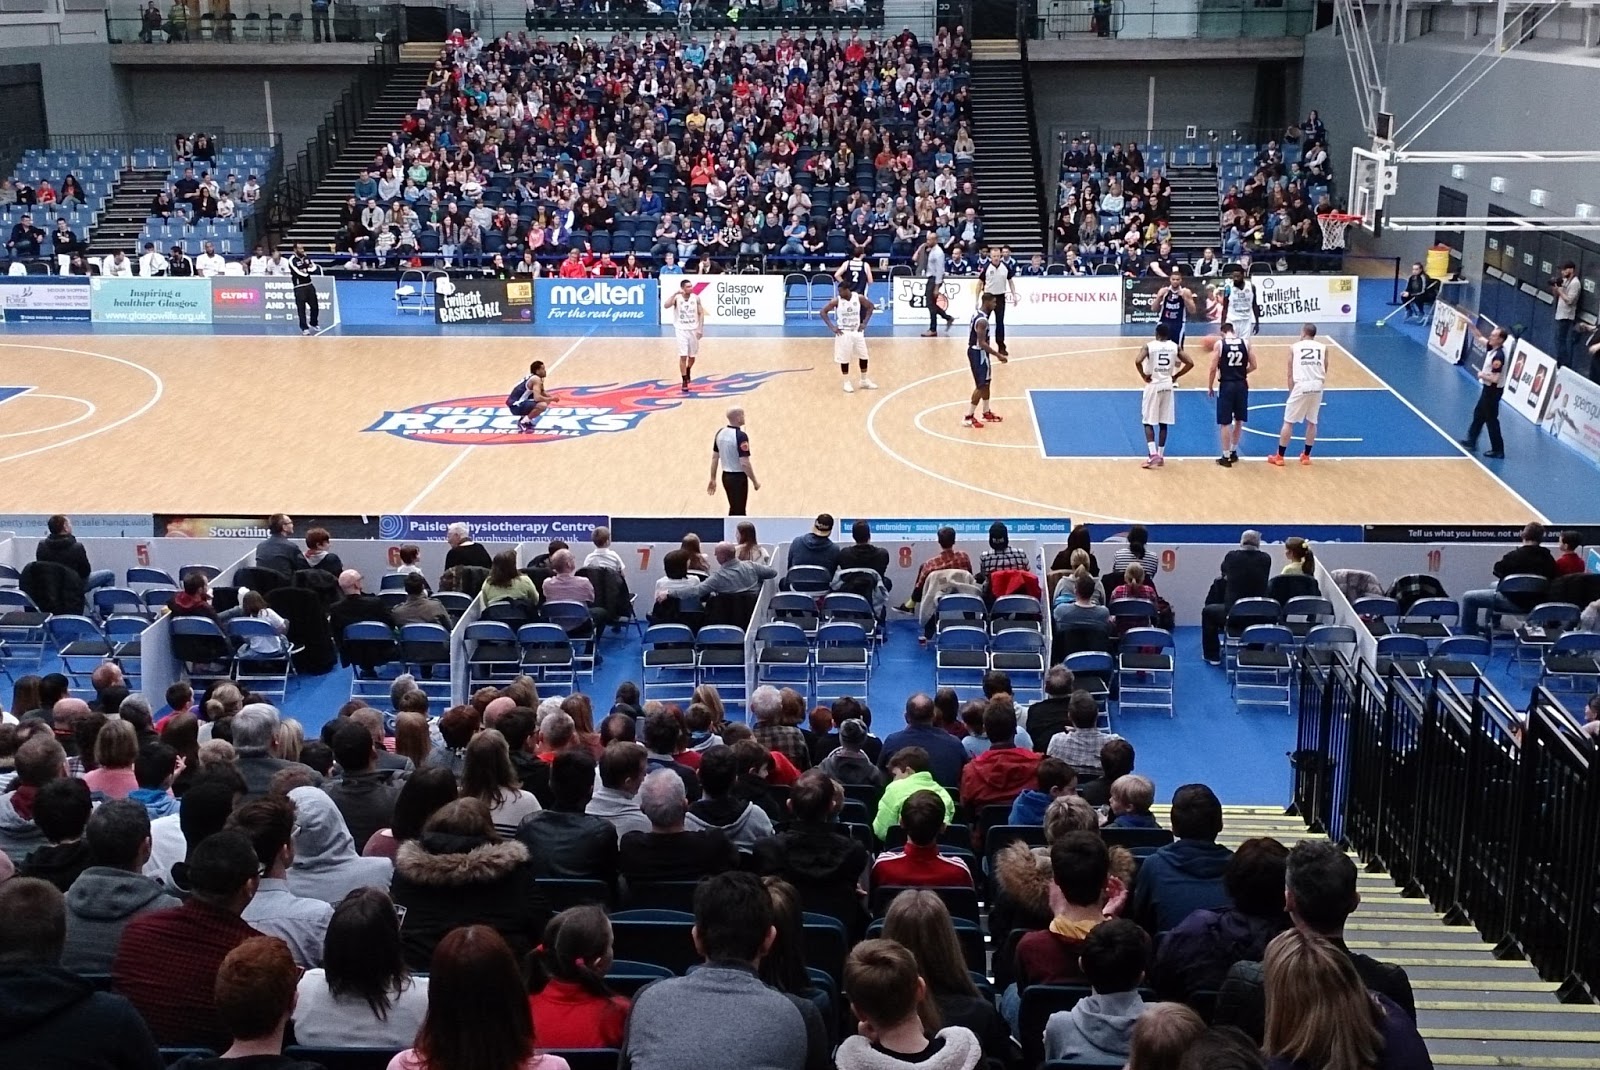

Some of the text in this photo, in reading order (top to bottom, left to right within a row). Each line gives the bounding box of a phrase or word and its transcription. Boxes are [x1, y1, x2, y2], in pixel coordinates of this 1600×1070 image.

[852, 271, 859, 282] 2
[130, 289, 173, 300] Inspiring
[221, 292, 254, 300] CLYDE 1
[265, 292, 284, 300] FOR
[550, 282, 645, 306] molten
[716, 282, 764, 296] Glasgow
[898, 280, 960, 302] jup
[1262, 286, 1301, 304] twilight
[113, 298, 198, 309] healthier Glasgow
[443, 290, 482, 308] twilight
[717, 294, 751, 305] Kelvin
[1041, 292, 1118, 303] PHOENIX KIA
[1132, 298, 1147, 306] One
[265, 302, 285, 310] AND
[439, 301, 502, 323] BASKETBALL
[716, 305, 756, 319] College
[1257, 297, 1321, 318] BASKETBALL
[105, 311, 207, 322] www.glasgowlife.org.uk
[547, 307, 645, 322] For the real game
[1158, 353, 1171, 366] 5
[1227, 351, 1243, 367] 22
[1300, 348, 1321, 360] 21
[374, 412, 639, 431] ROCKS
[463, 521, 549, 534] hysiotherapy
[551, 521, 596, 532] Centre
[875, 523, 912, 532] embroidery
[965, 523, 980, 532] print
[1017, 523, 1035, 532] polos
[1040, 523, 1065, 531] hoodies
[1408, 529, 1422, 537] Tell
[1434, 529, 1454, 537] what
[137, 544, 150, 567] 5
[386, 546, 401, 567] 6
[635, 547, 652, 571] 7
[898, 546, 912, 568] 8
[1161, 549, 1176, 573] 9
[1427, 550, 1442, 573] 10
